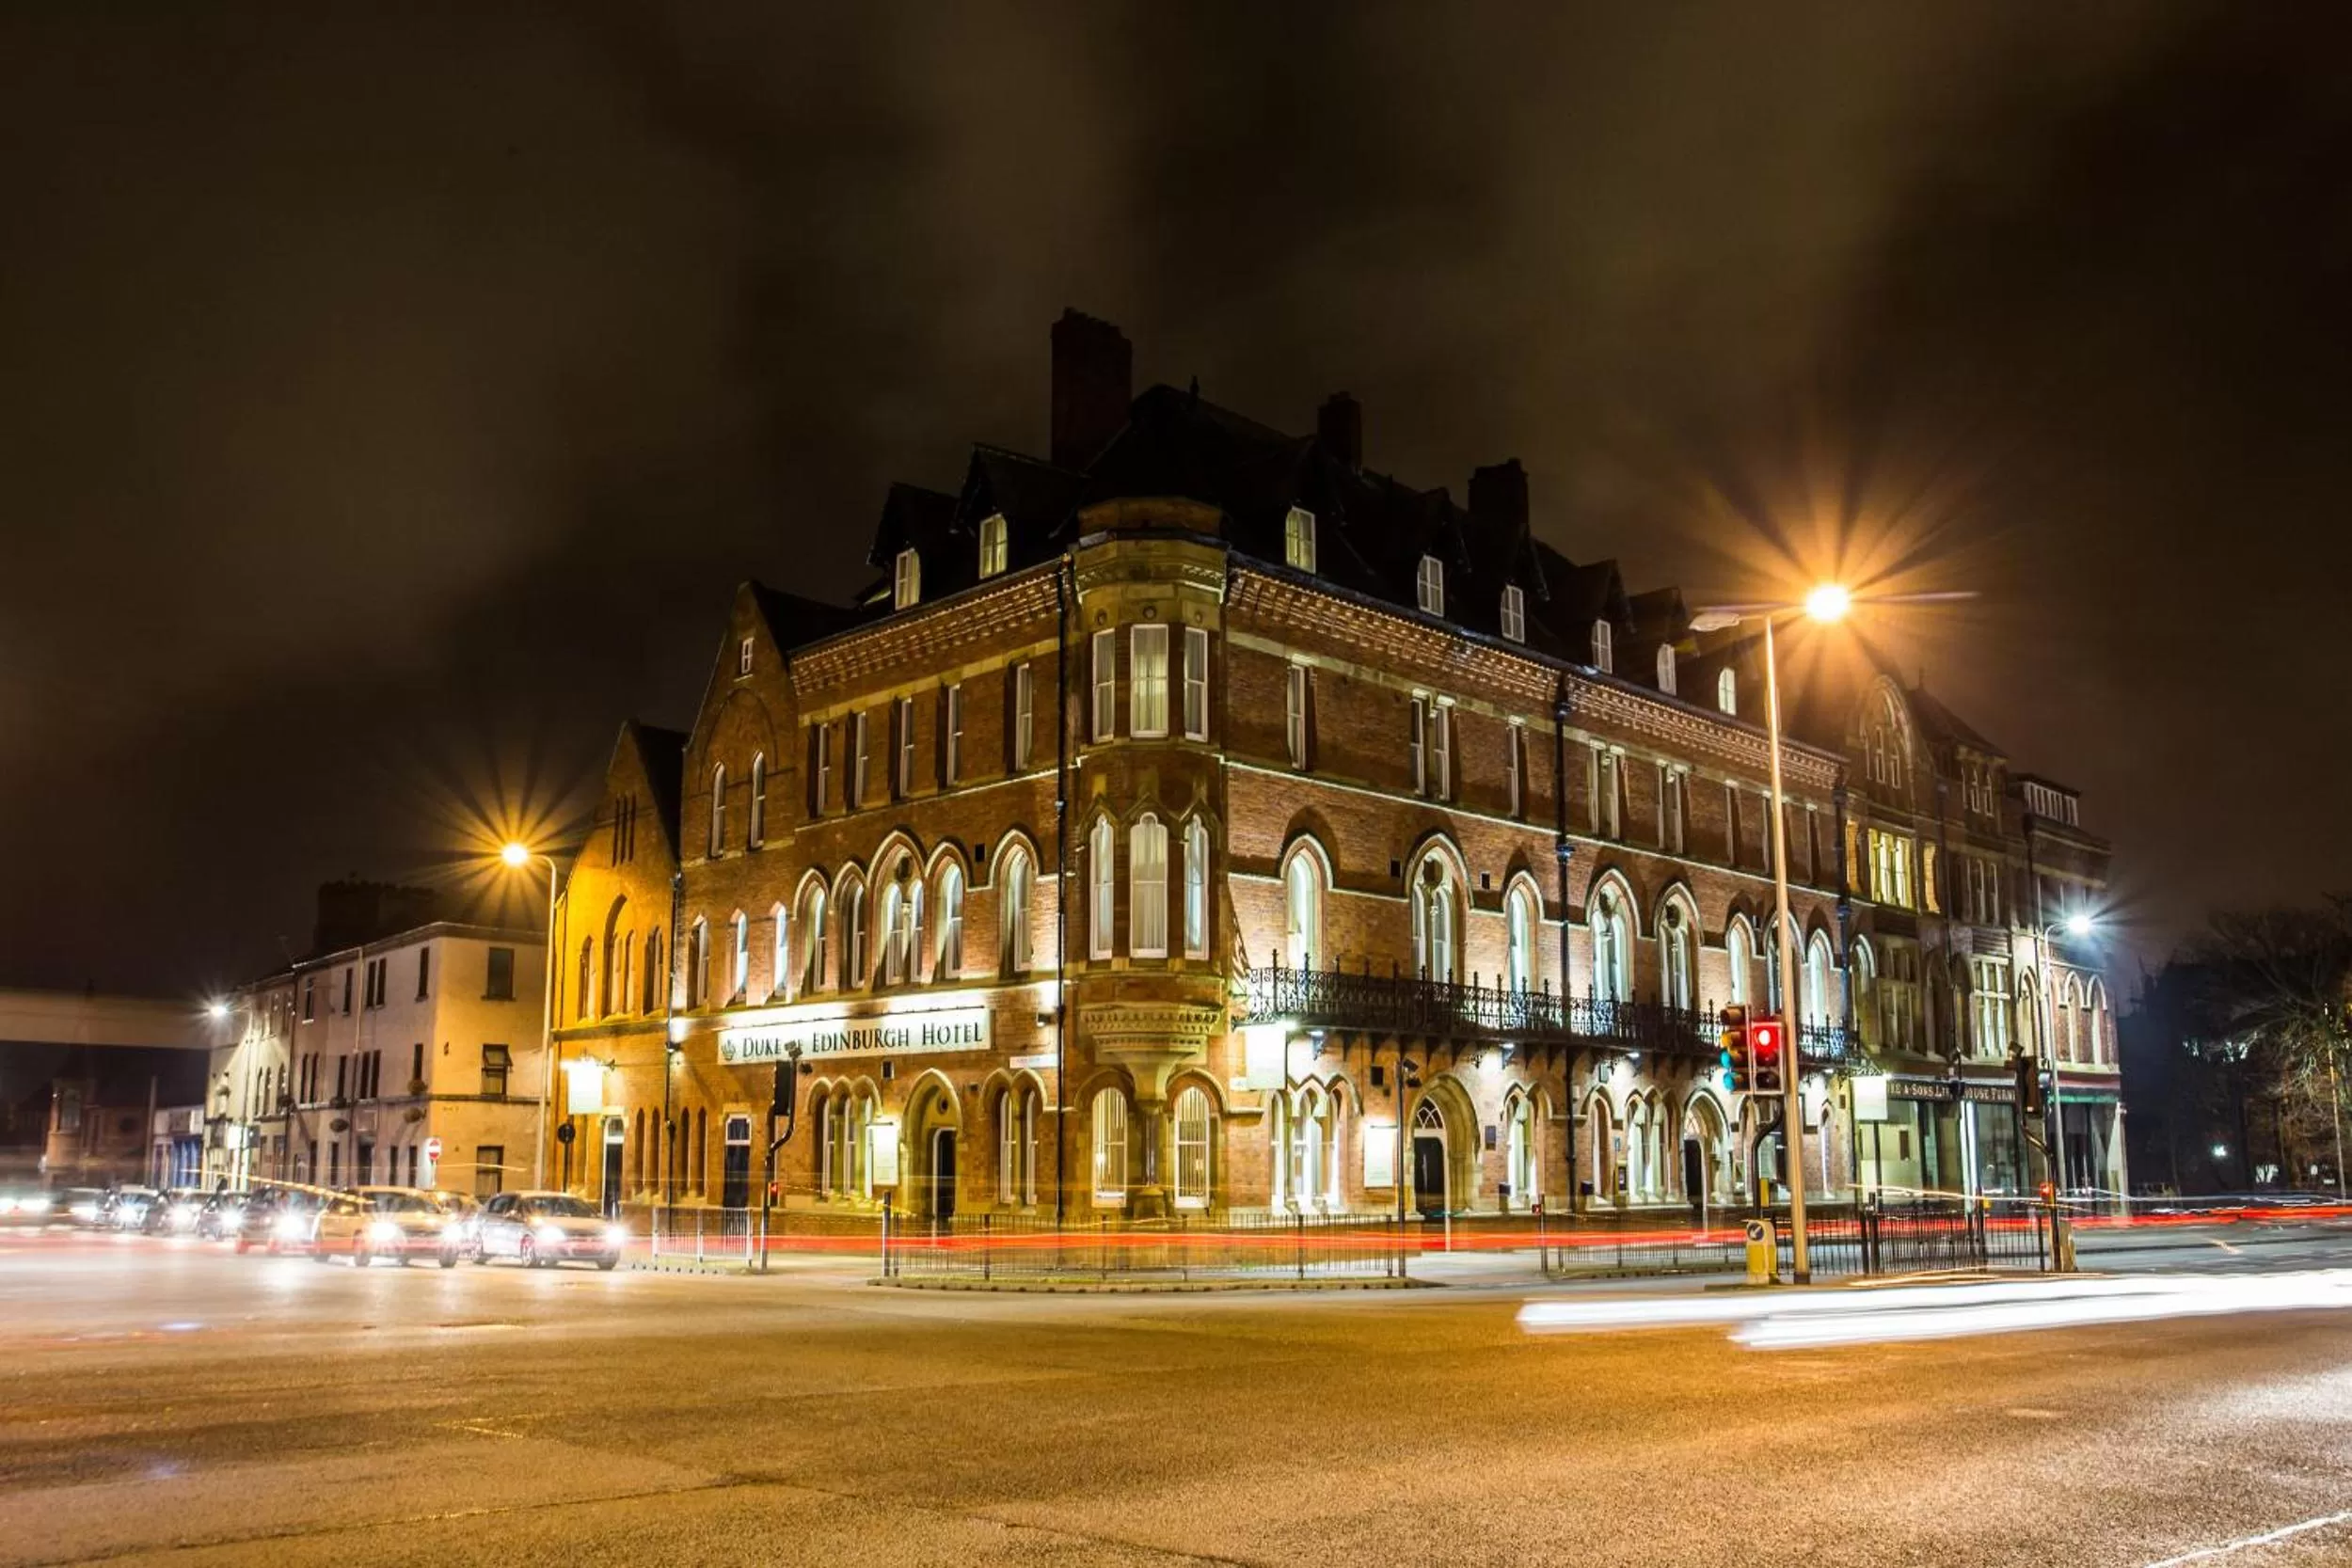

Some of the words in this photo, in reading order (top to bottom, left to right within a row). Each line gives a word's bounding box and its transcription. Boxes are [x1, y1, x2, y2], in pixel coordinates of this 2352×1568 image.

[742, 1037, 781, 1058] DUKE
[812, 1026, 910, 1053] EDINBURGH
[922, 1022, 983, 1046] HOTEL
